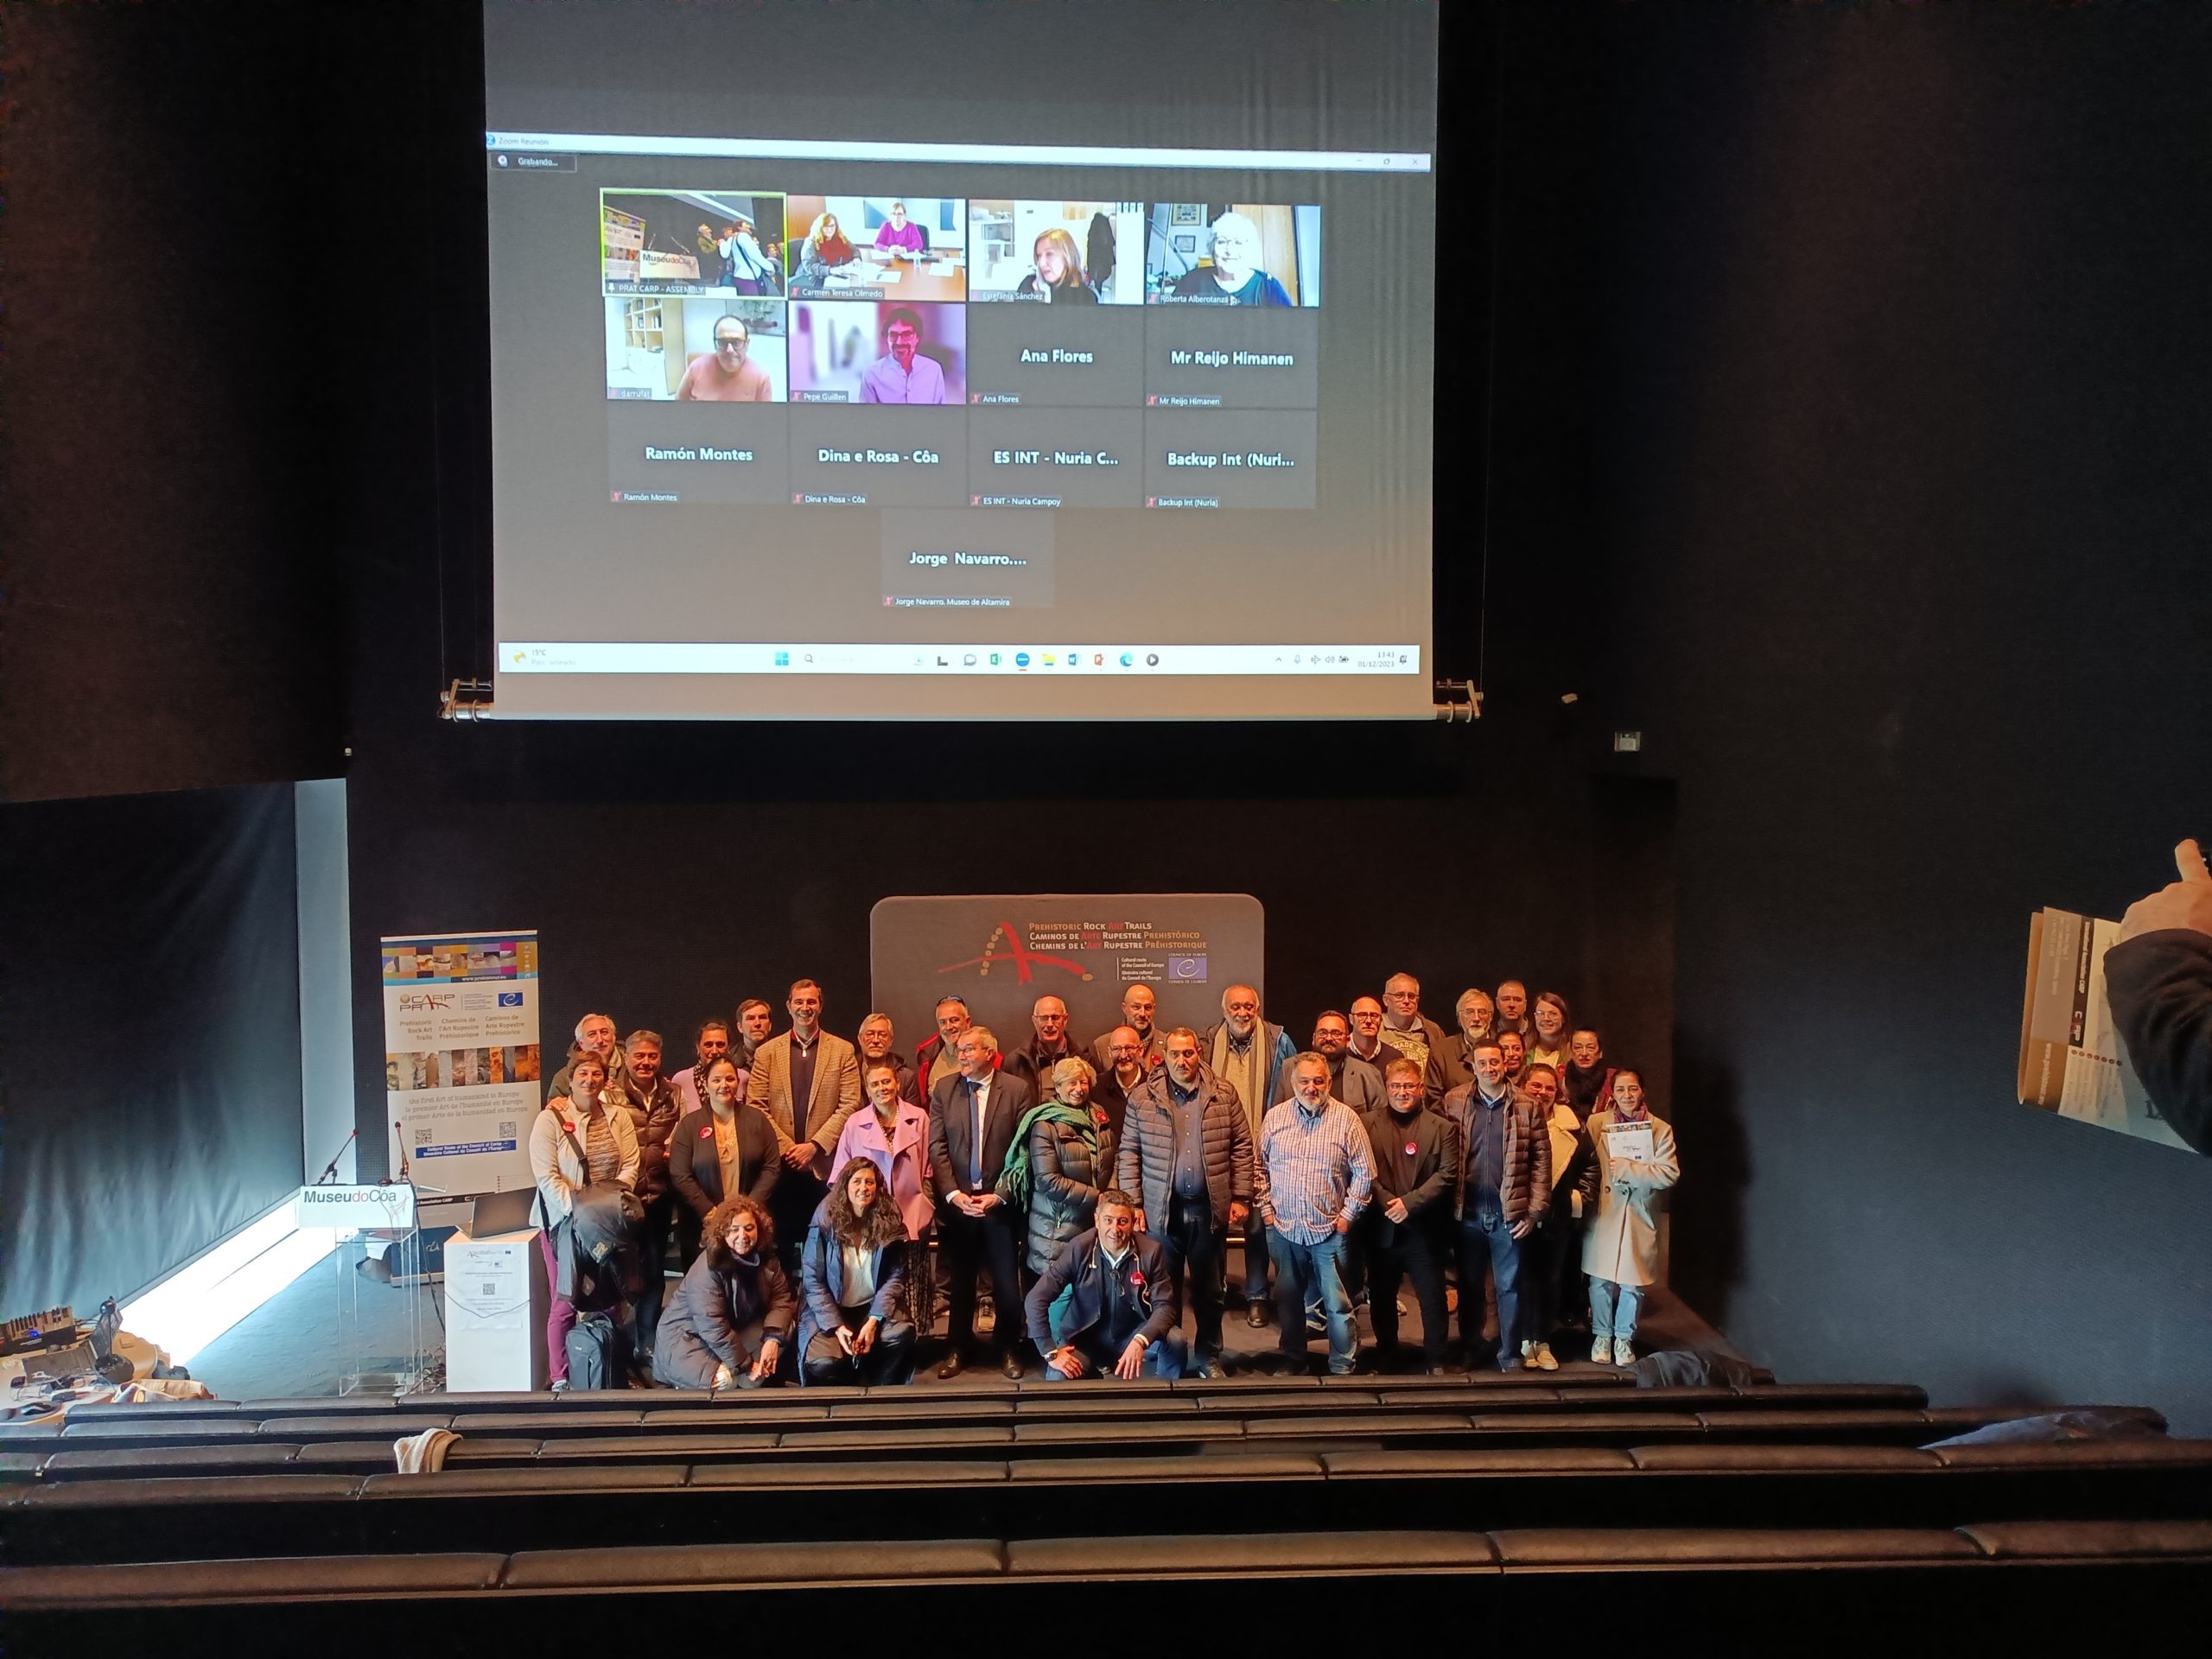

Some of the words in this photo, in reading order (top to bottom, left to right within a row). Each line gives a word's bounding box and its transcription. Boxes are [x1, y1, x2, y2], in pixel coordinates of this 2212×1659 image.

[518, 157, 558, 166] Grabando...
[1015, 291, 1043, 300] Sánchez
[1188, 295, 1229, 303] Alberotanza
[1020, 349, 1048, 364] Ana
[1052, 349, 1094, 365] Flores
[1171, 351, 1192, 365] Mr
[1195, 351, 1229, 368] Reijo
[1232, 351, 1294, 366] Himanen
[804, 393, 821, 402] Pepe
[982, 395, 997, 404] Ana
[1171, 397, 1188, 407] Reijo
[1189, 397, 1220, 405] Himanen
[645, 446, 696, 461] Ramón
[699, 448, 753, 462] Montes
[818, 449, 851, 463] Dina
[855, 453, 863, 463] e
[867, 450, 900, 464] Rosa
[912, 449, 939, 464] Côa
[994, 451, 1010, 464] ES
[1014, 452, 1039, 465] INT
[1054, 451, 1092, 466] Nuria
[1096, 452, 1119, 466] C...
[1167, 453, 1217, 468] Backup
[1223, 453, 1242, 467] Int
[1247, 453, 1294, 469] (Nuri...
[623, 493, 650, 502] Ramón
[651, 493, 677, 502] Montes
[804, 495, 821, 504] Dina
[829, 495, 845, 504] Rosa
[852, 495, 866, 504] Côa
[1032, 498, 1061, 508] Campoy
[1158, 499, 1183, 508] Backup
[1184, 499, 1193, 507] Int
[1194, 499, 1218, 508] (Nuria)
[909, 552, 949, 568] Jorge
[895, 598, 915, 607] Jorge
[981, 598, 1010, 607] Altamira
[1029, 941, 1067, 950] CHEMINS
